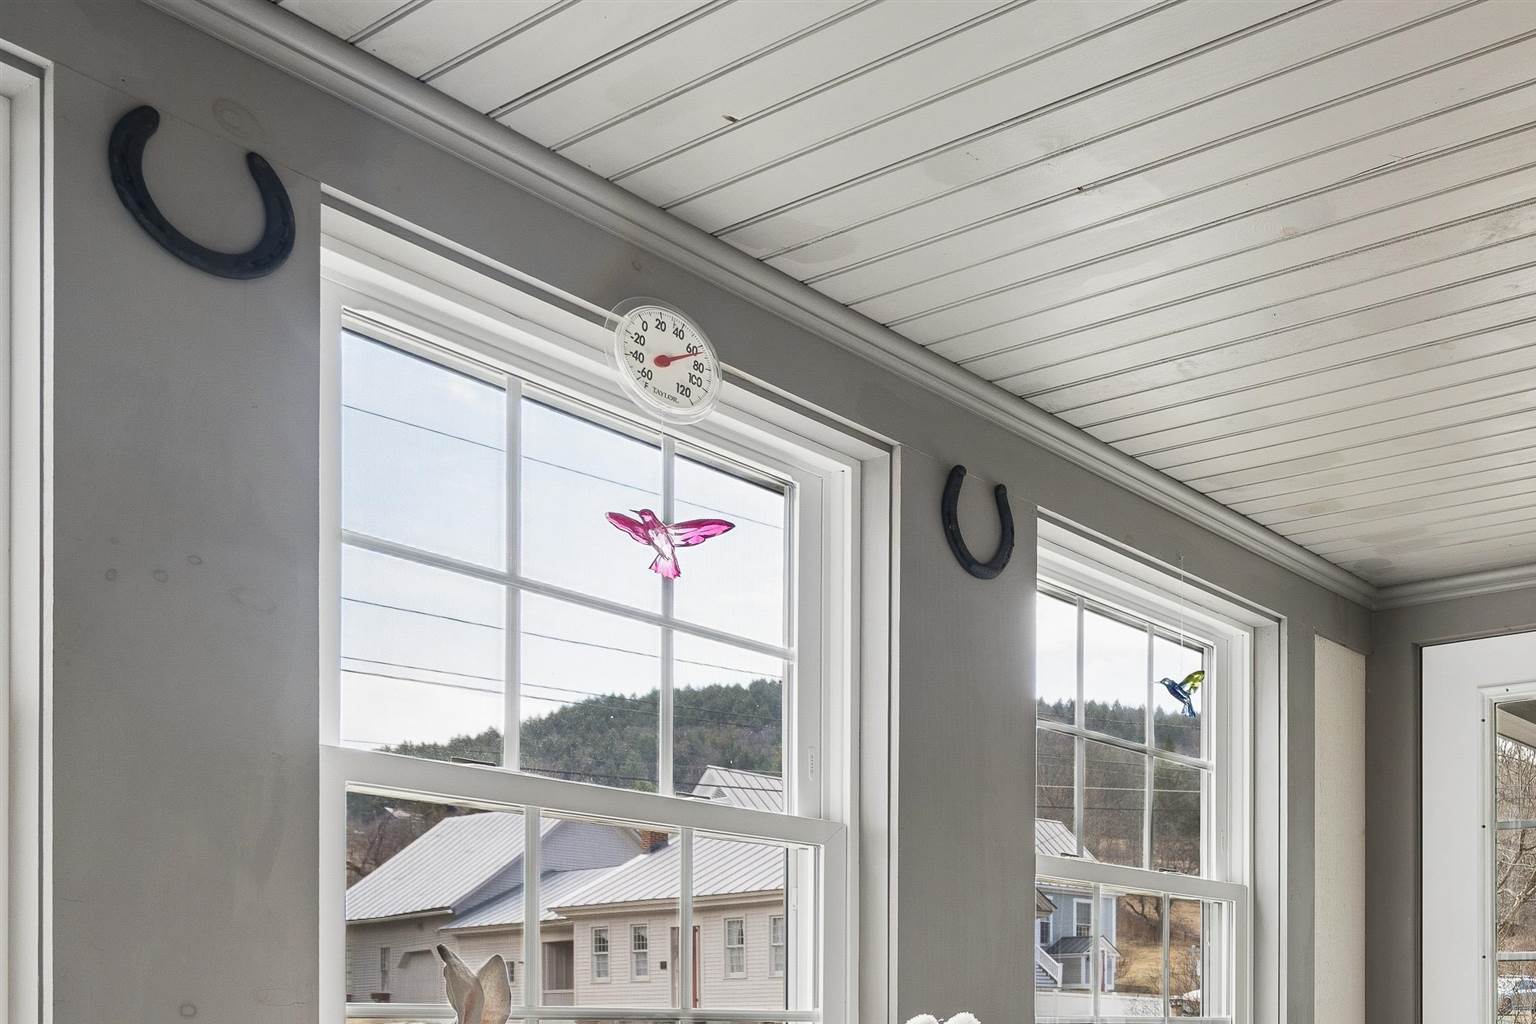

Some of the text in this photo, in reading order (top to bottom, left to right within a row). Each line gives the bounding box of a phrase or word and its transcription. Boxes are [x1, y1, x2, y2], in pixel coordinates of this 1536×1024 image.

[642, 321, 648, 332] 0
[655, 318, 667, 332] 20
[630, 332, 646, 346] -20
[672, 327, 685, 340] 40
[686, 343, 698, 356] 60
[629, 350, 645, 364] -40
[692, 360, 704, 373] 80
[637, 367, 653, 380] -60
[688, 372, 703, 388] 100
[676, 382, 691, 398] 120
